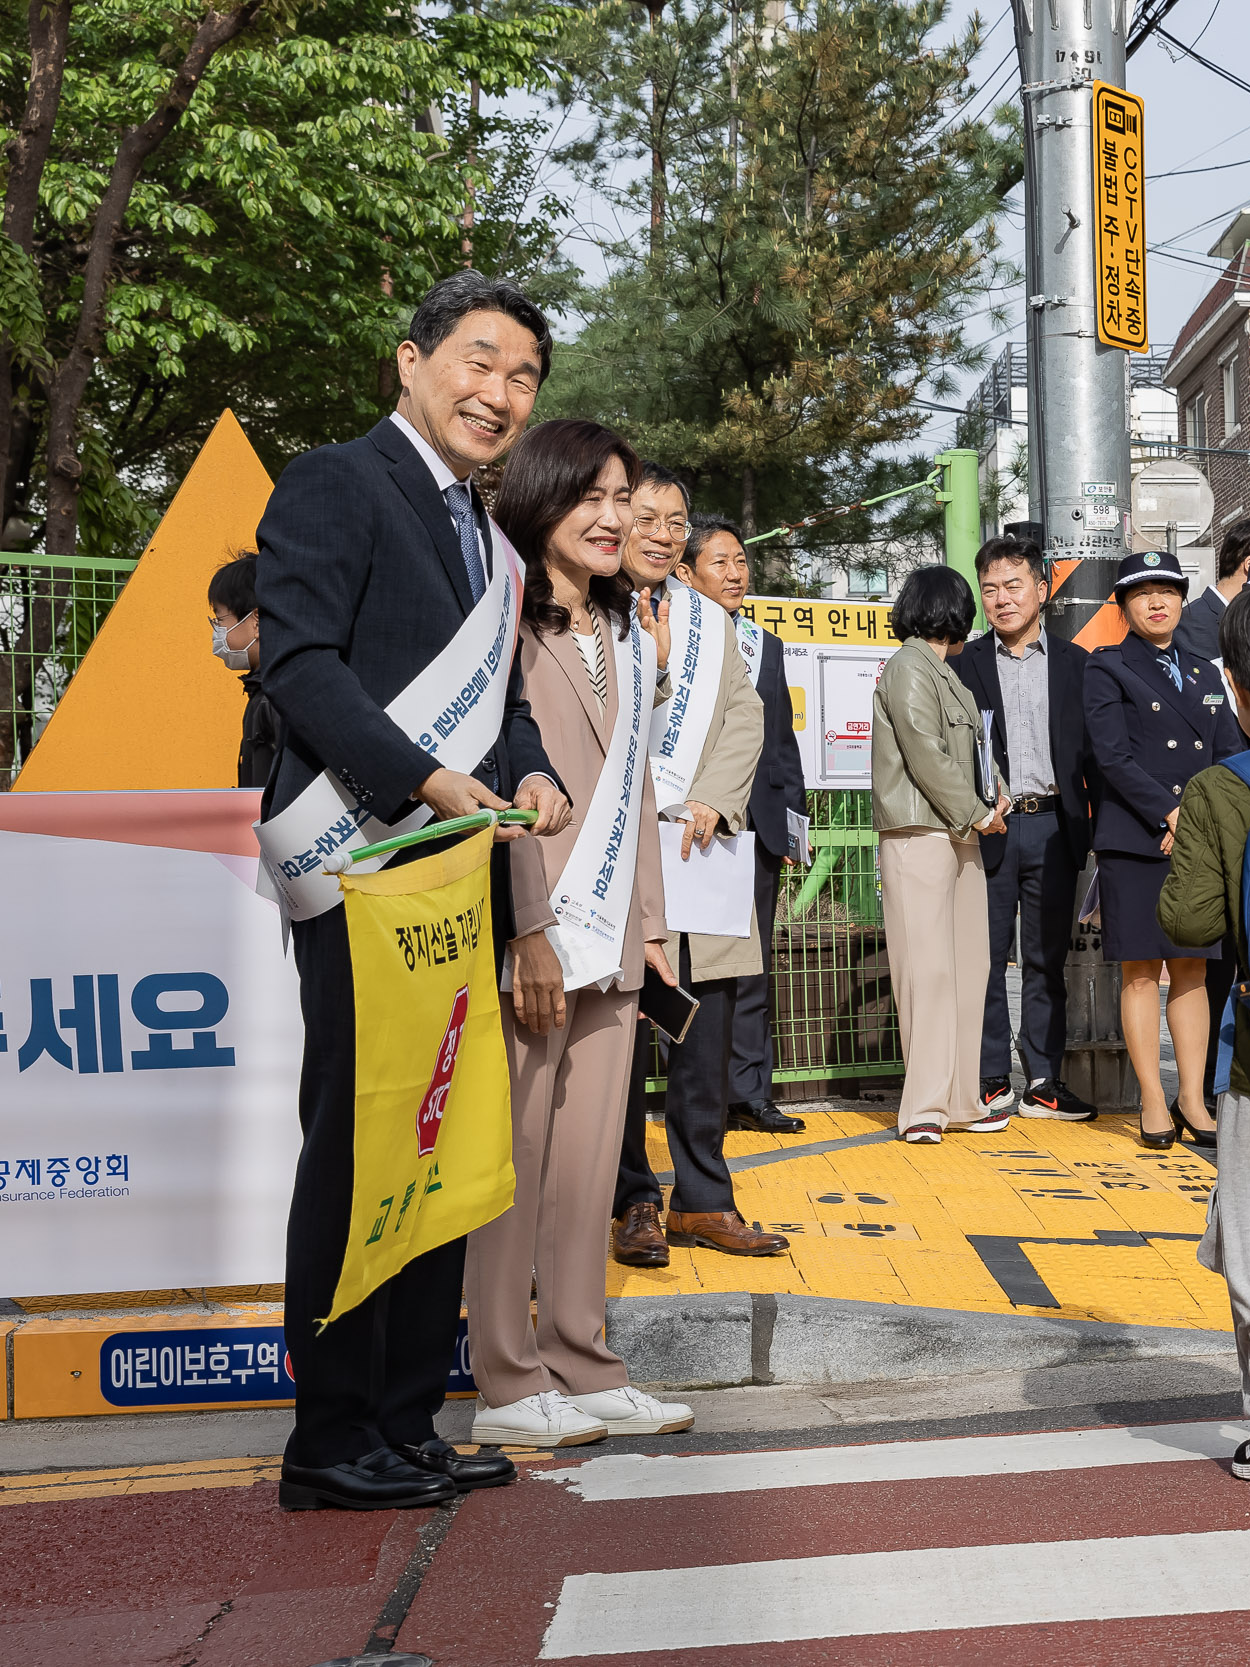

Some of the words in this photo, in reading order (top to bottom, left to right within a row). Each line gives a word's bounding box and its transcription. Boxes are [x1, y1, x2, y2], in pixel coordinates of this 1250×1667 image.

[1101, 137, 1119, 207] 불법
[1124, 249, 1142, 336] 단속중
[1093, 505, 1110, 515] 598
[680, 628, 702, 686] 안전하게
[437, 665, 492, 741] 등하굣길
[658, 684, 691, 759] 지켜주세요
[619, 733, 639, 809] 안전하게
[277, 804, 375, 881] 지켜주세요
[591, 806, 628, 901] 지켜주세요
[395, 916, 459, 972] 정지선을
[456, 896, 485, 953] 지킵
[423, 1079, 450, 1125] STO
[59, 1185, 130, 1199] Federation
[110, 1342, 279, 1389] 어린이보호구역
